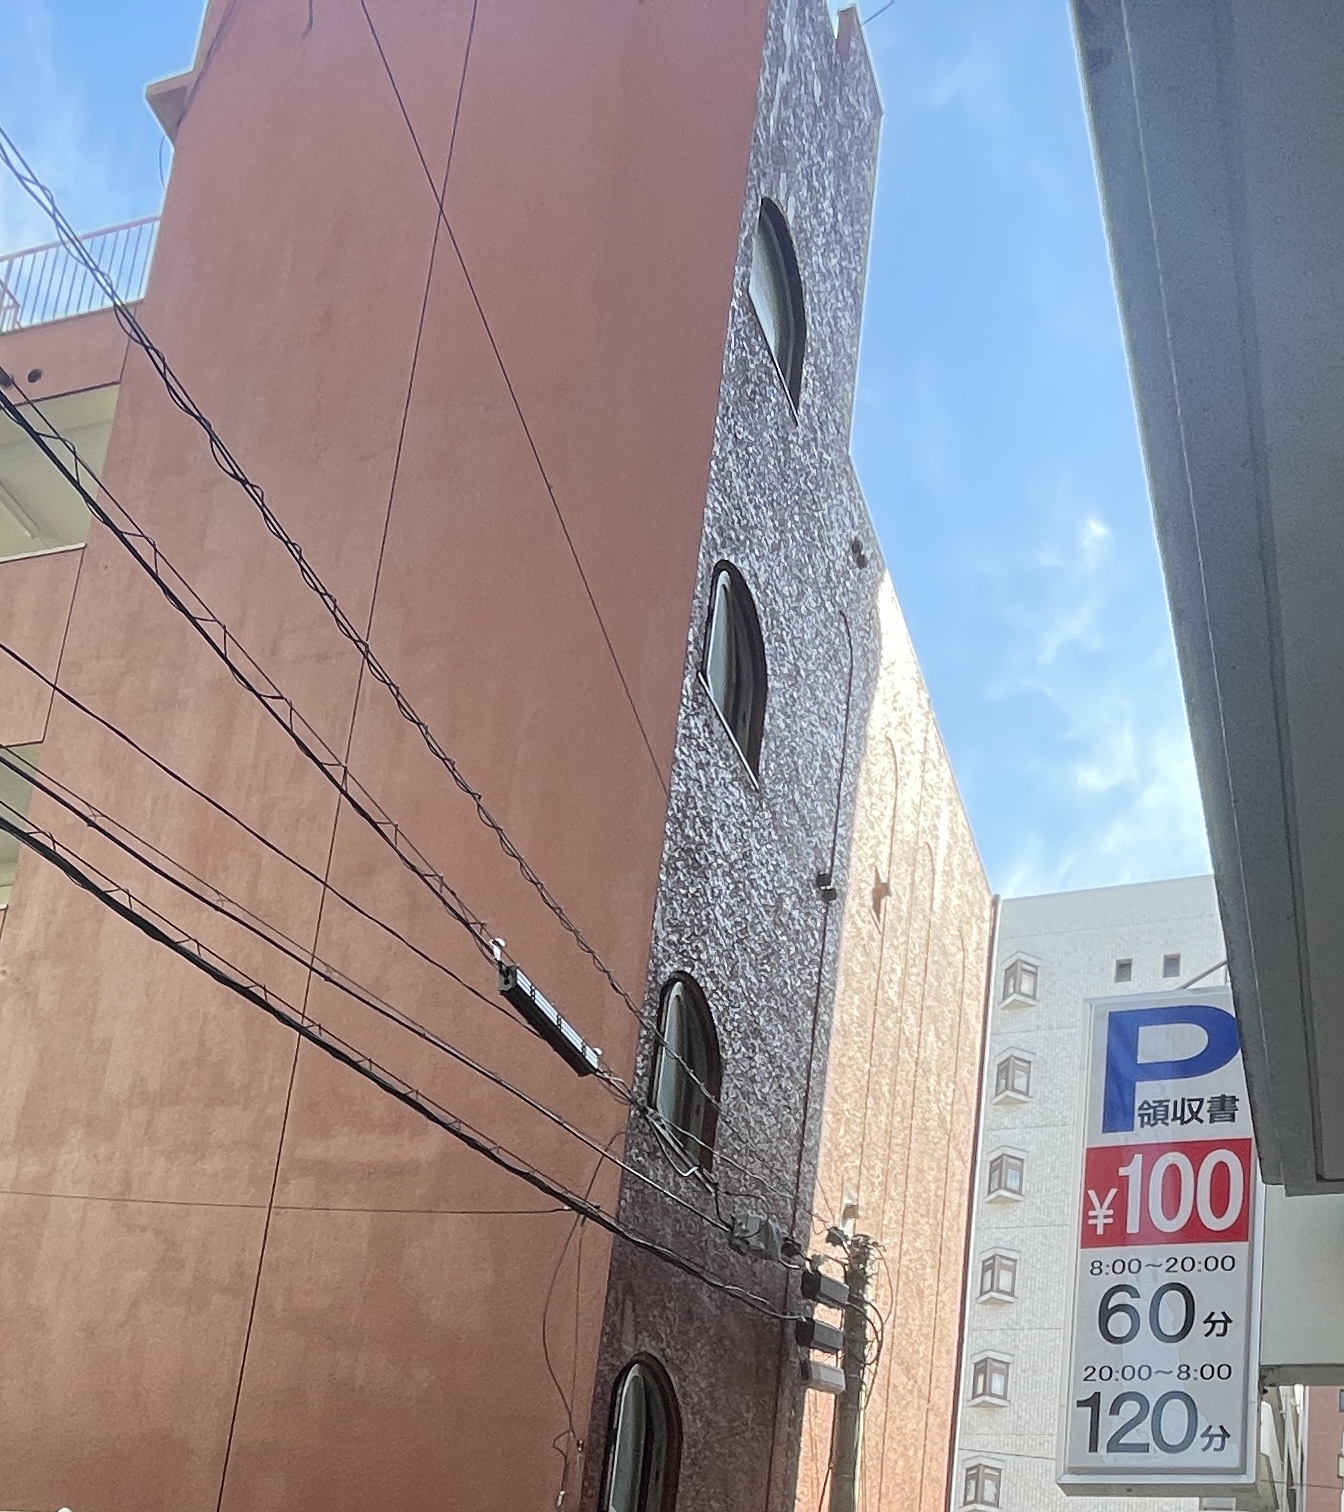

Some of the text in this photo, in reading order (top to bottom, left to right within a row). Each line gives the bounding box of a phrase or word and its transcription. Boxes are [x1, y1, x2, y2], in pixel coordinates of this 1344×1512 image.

[1102, 1005, 1241, 1134] P
[1137, 1094, 1240, 1128] 領収書
[1087, 1148, 1244, 1236] ¥100
